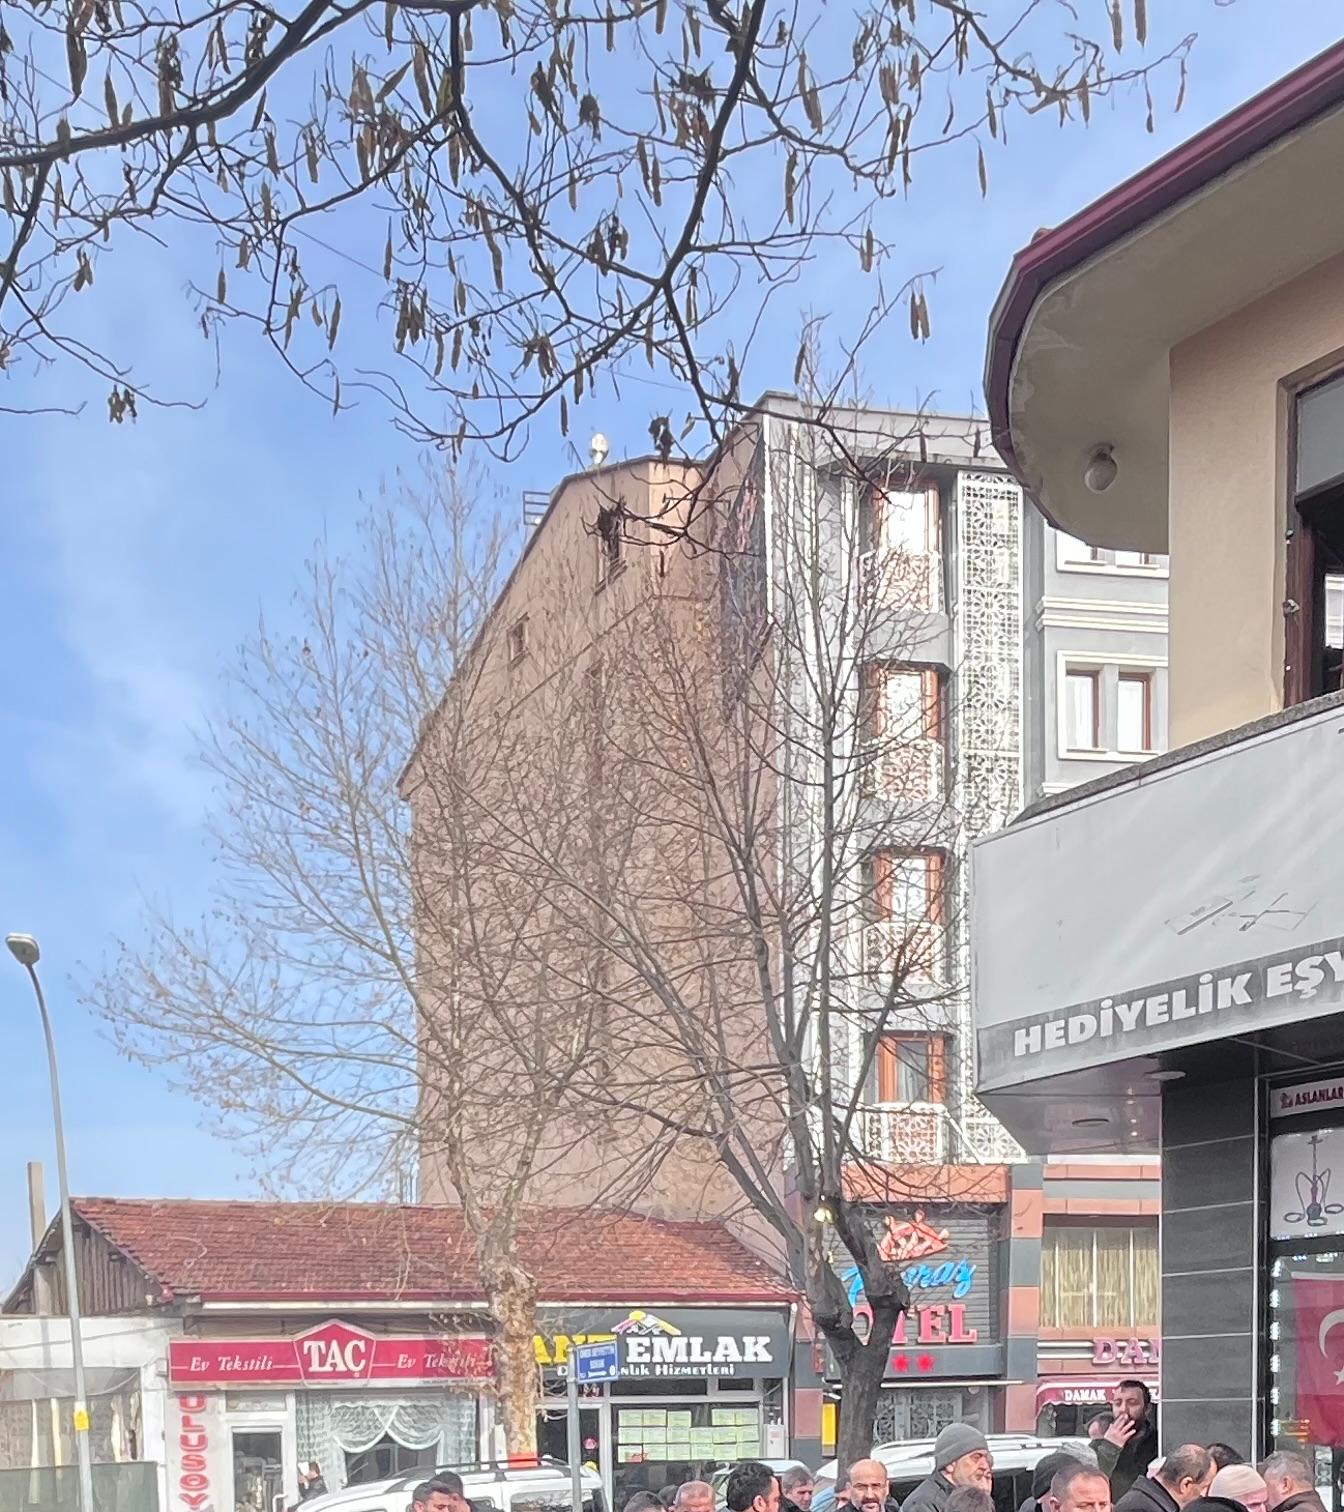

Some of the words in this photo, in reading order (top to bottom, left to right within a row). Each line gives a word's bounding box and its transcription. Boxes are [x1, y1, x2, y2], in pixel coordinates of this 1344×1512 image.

[1013, 972, 1253, 1057] HEDİYELİK
[1294, 1084, 1344, 1107] ASLANLAR
[397, 1353, 416, 1369] Ev
[626, 1336, 773, 1363] EMLAK
[190, 1356, 210, 1371] Ev
[218, 1354, 273, 1371] Tekstili
[1064, 1389, 1107, 1401] DAMAK
[179, 1392, 210, 1512] ULUSOY
